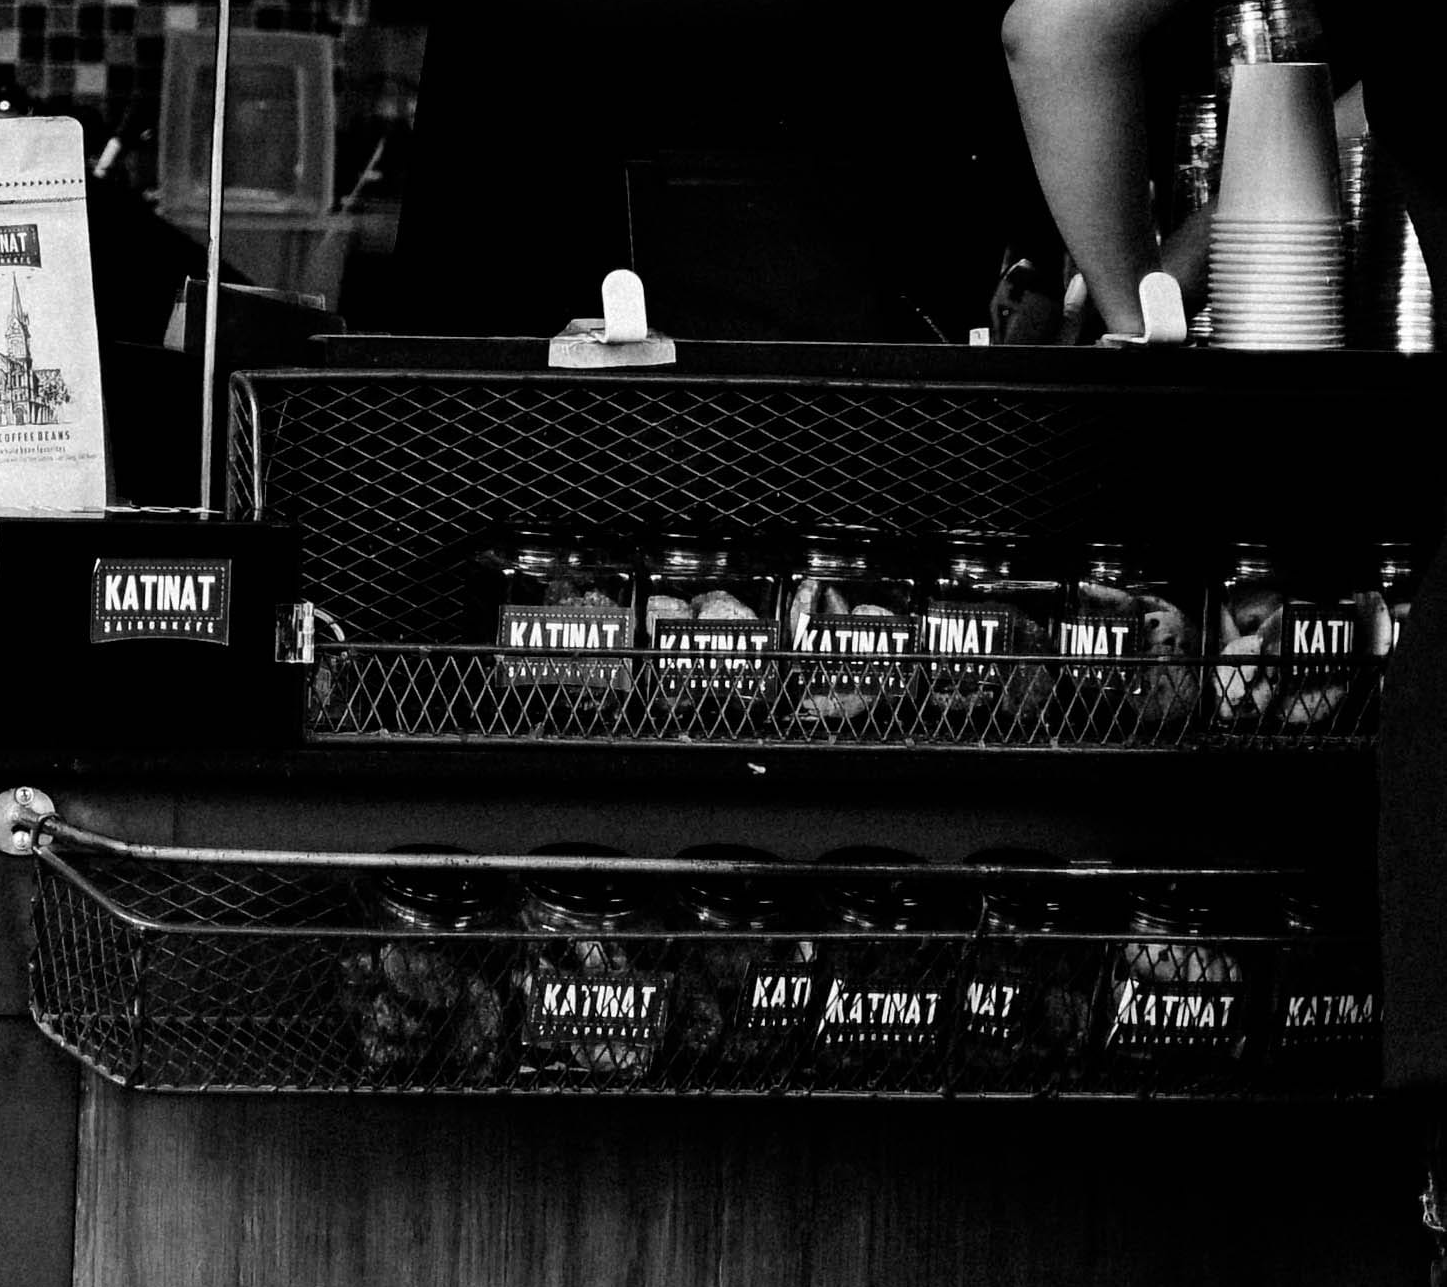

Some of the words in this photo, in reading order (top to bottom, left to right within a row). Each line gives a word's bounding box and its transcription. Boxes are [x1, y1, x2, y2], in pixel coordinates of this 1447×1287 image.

[0, 432, 34, 444] COFFEE
[105, 575, 216, 611] KATINAT
[510, 621, 620, 649] KATINAT
[542, 983, 657, 1018] KATINAT
[826, 993, 940, 1026] KATINAT
